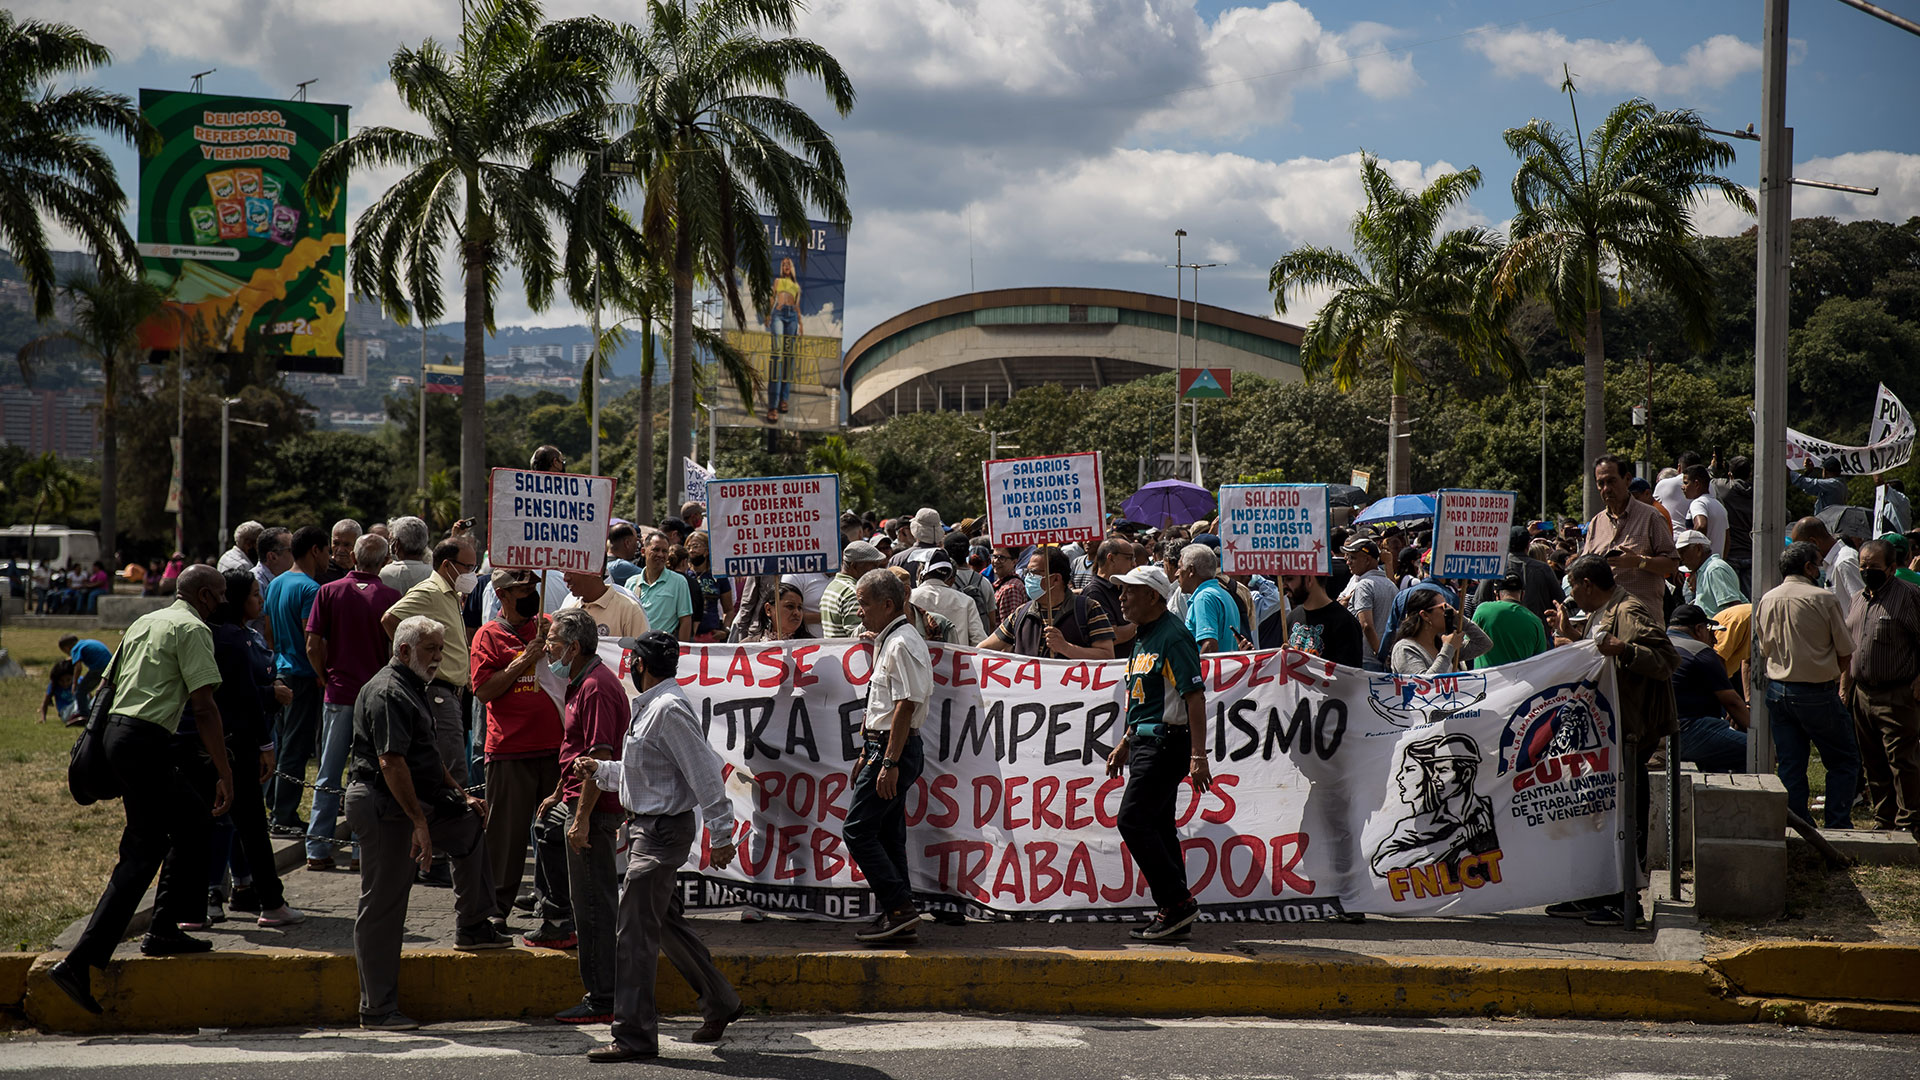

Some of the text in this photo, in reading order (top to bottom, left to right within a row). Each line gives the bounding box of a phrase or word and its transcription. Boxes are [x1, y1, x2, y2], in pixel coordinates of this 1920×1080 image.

[204, 111, 286, 127] DELICIOSO,
[194, 126, 296, 145] REFRESCANTE
[201, 145, 290, 160] Y RENDIDOR
[1013, 459, 1070, 475] SALARIOS
[515, 472, 593, 497] SALARIO Y
[720, 483, 778, 498] GOBERNE
[782, 481, 820, 495] QUIEN
[1002, 473, 1079, 490] Y PENSIONES
[742, 496, 804, 511] GOBIERNE
[1002, 488, 1081, 505] INDEXADOS A
[1245, 491, 1300, 507] SALARIO
[1446, 496, 1509, 509] UNIDAD OBRERA
[514, 497, 595, 522] PENSIONES
[1007, 502, 1081, 518] LA CANASTA
[1231, 508, 1309, 521] INDEXADO A
[1446, 511, 1509, 523] PARA DERROTAR
[727, 510, 820, 527] LOS DERECHOS
[524, 521, 579, 543] DIGNAS
[737, 525, 811, 540] DEL PUEBLO
[1232, 522, 1312, 535] LA CANASTA
[1454, 525, 1464, 537] LA
[1004, 529, 1090, 546] CUTV-FNLCT
[1251, 536, 1299, 549] BASICA
[733, 538, 820, 556] SE DEFIENDEN
[506, 545, 591, 570] FNLCT-CUTV
[728, 555, 823, 576] CUTV FNLCT
[1237, 553, 1314, 570] CUTV-FNLCT
[842, 643, 1042, 690] ORERA
[1059, 662, 1119, 691] AL
[1131, 677, 1145, 704] 4
[1514, 739, 1521, 751] LA
[1512, 771, 1617, 805] CENTRAL UNITARIA
[754, 771, 848, 823] POR
[1511, 806, 1530, 818] DE
[1527, 799, 1617, 827] DE VENEZUELA
[1387, 849, 1504, 902] FNLCT
[705, 880, 814, 912] NACIONAL
[825, 895, 860, 917] DE
